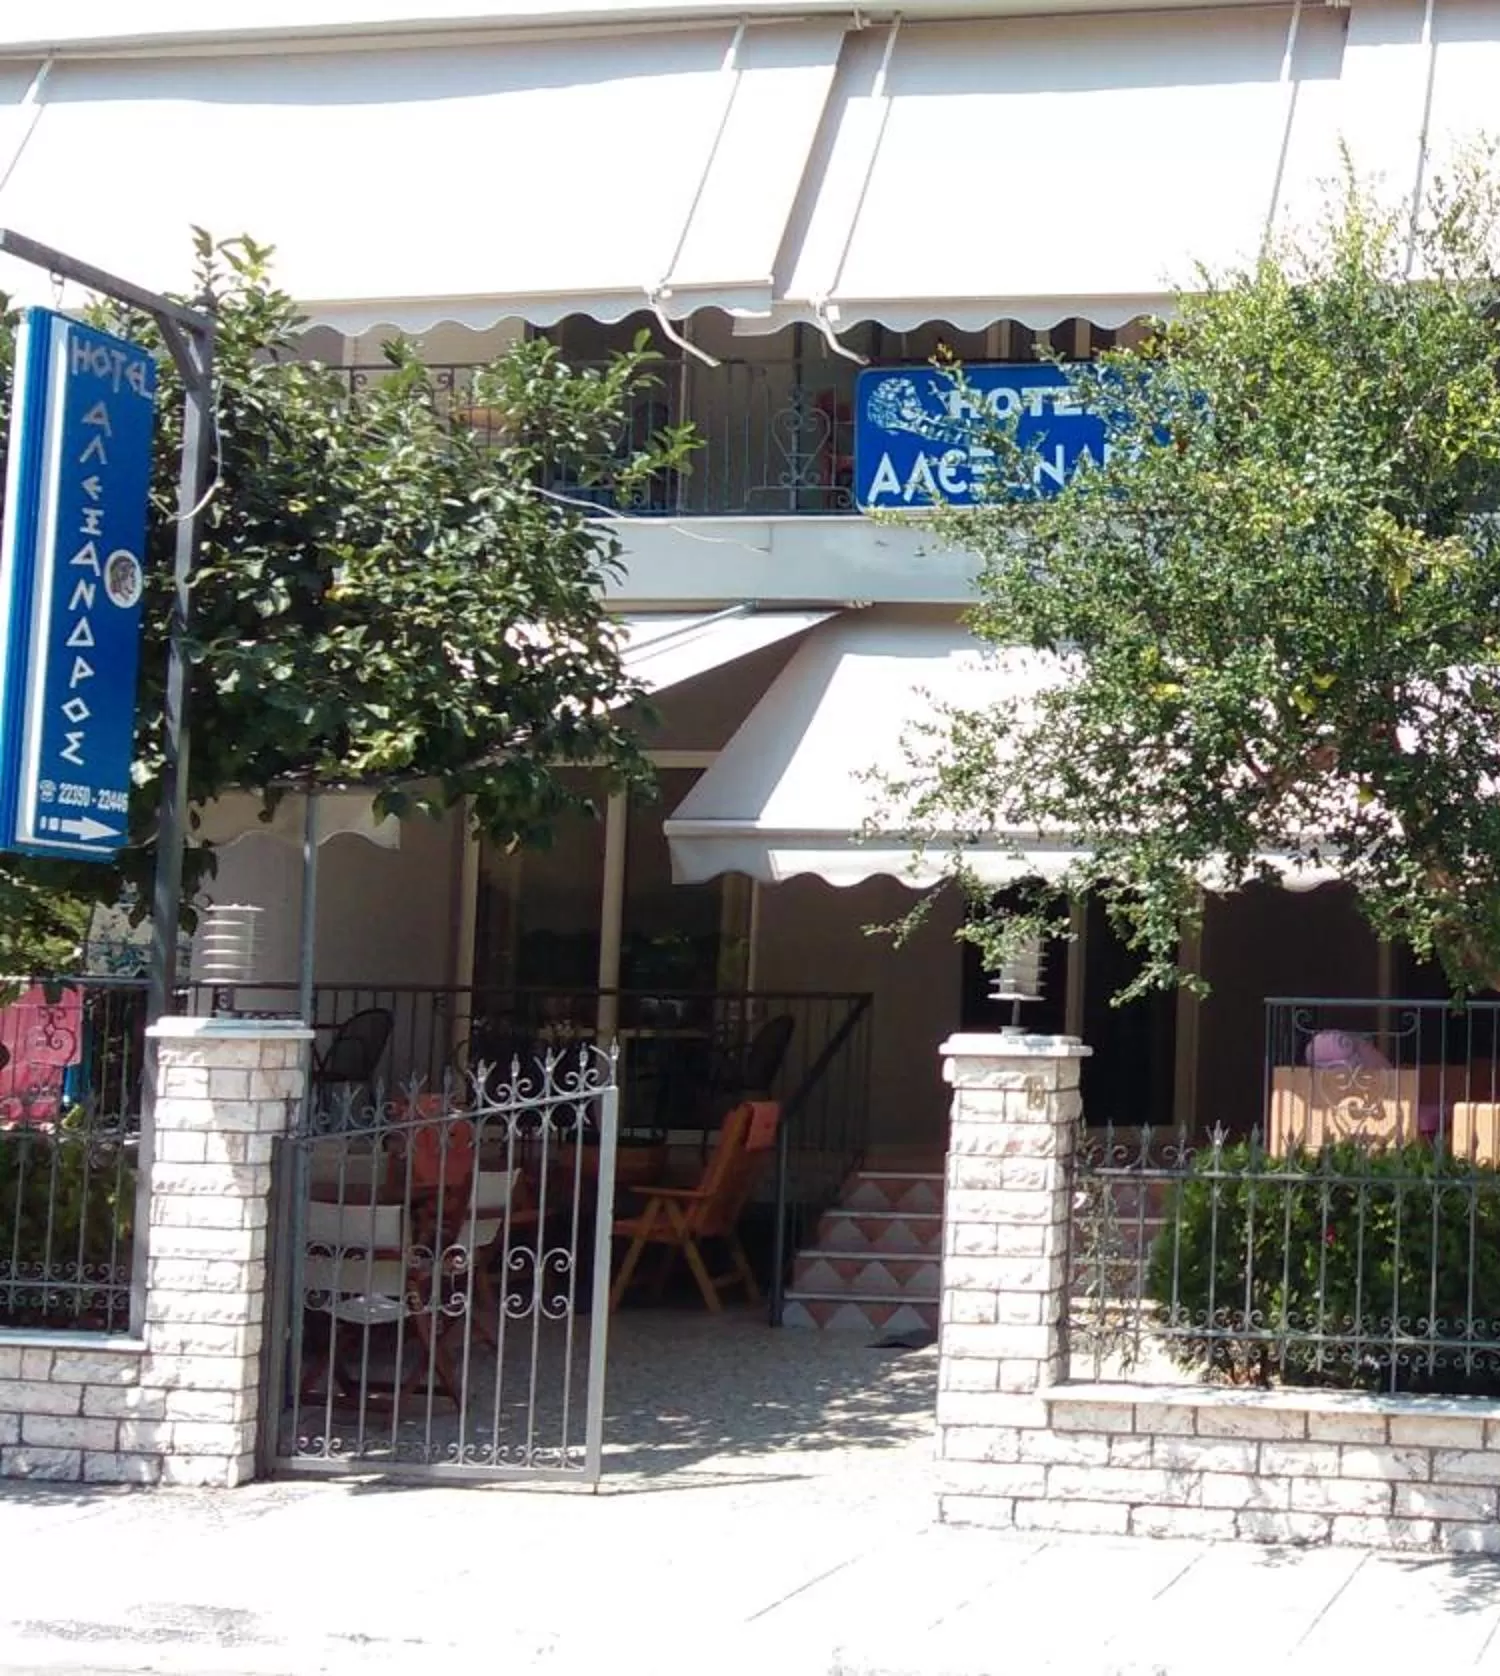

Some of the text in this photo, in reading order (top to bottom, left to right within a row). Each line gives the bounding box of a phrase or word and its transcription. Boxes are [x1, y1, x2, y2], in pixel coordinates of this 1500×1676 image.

[71, 336, 153, 400] HOTEL
[949, 385, 1112, 419] HOTE
[59, 400, 113, 766] ΑΛΕΞΑΝΔΡΟΣ
